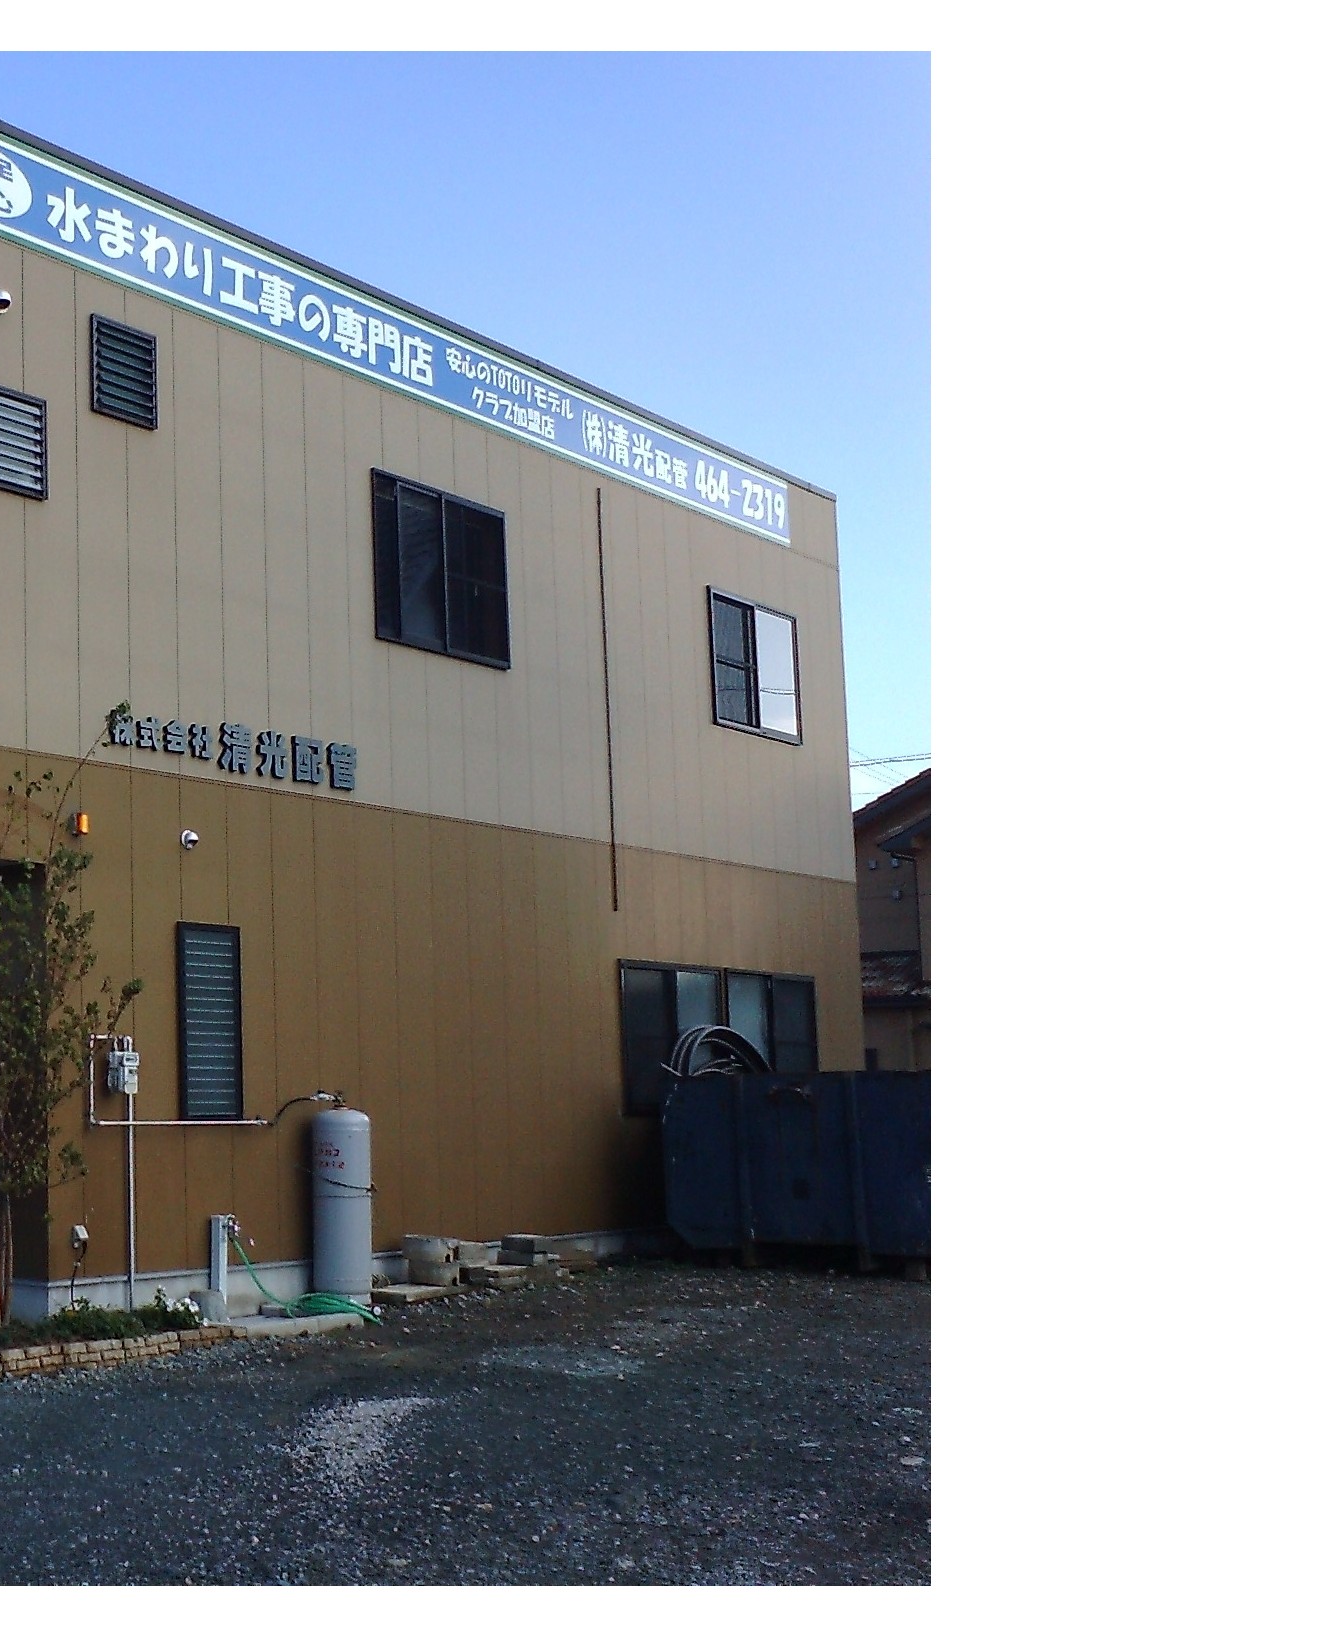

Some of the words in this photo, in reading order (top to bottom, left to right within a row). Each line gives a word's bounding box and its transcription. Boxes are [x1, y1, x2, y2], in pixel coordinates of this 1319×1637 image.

[46, 186, 434, 388] 水まわり工事の専門店
[445, 346, 574, 420] 安心のTOTOリモデル
[471, 386, 555, 441] クラブ加盟店
[694, 459, 785, 530] 464-2319
